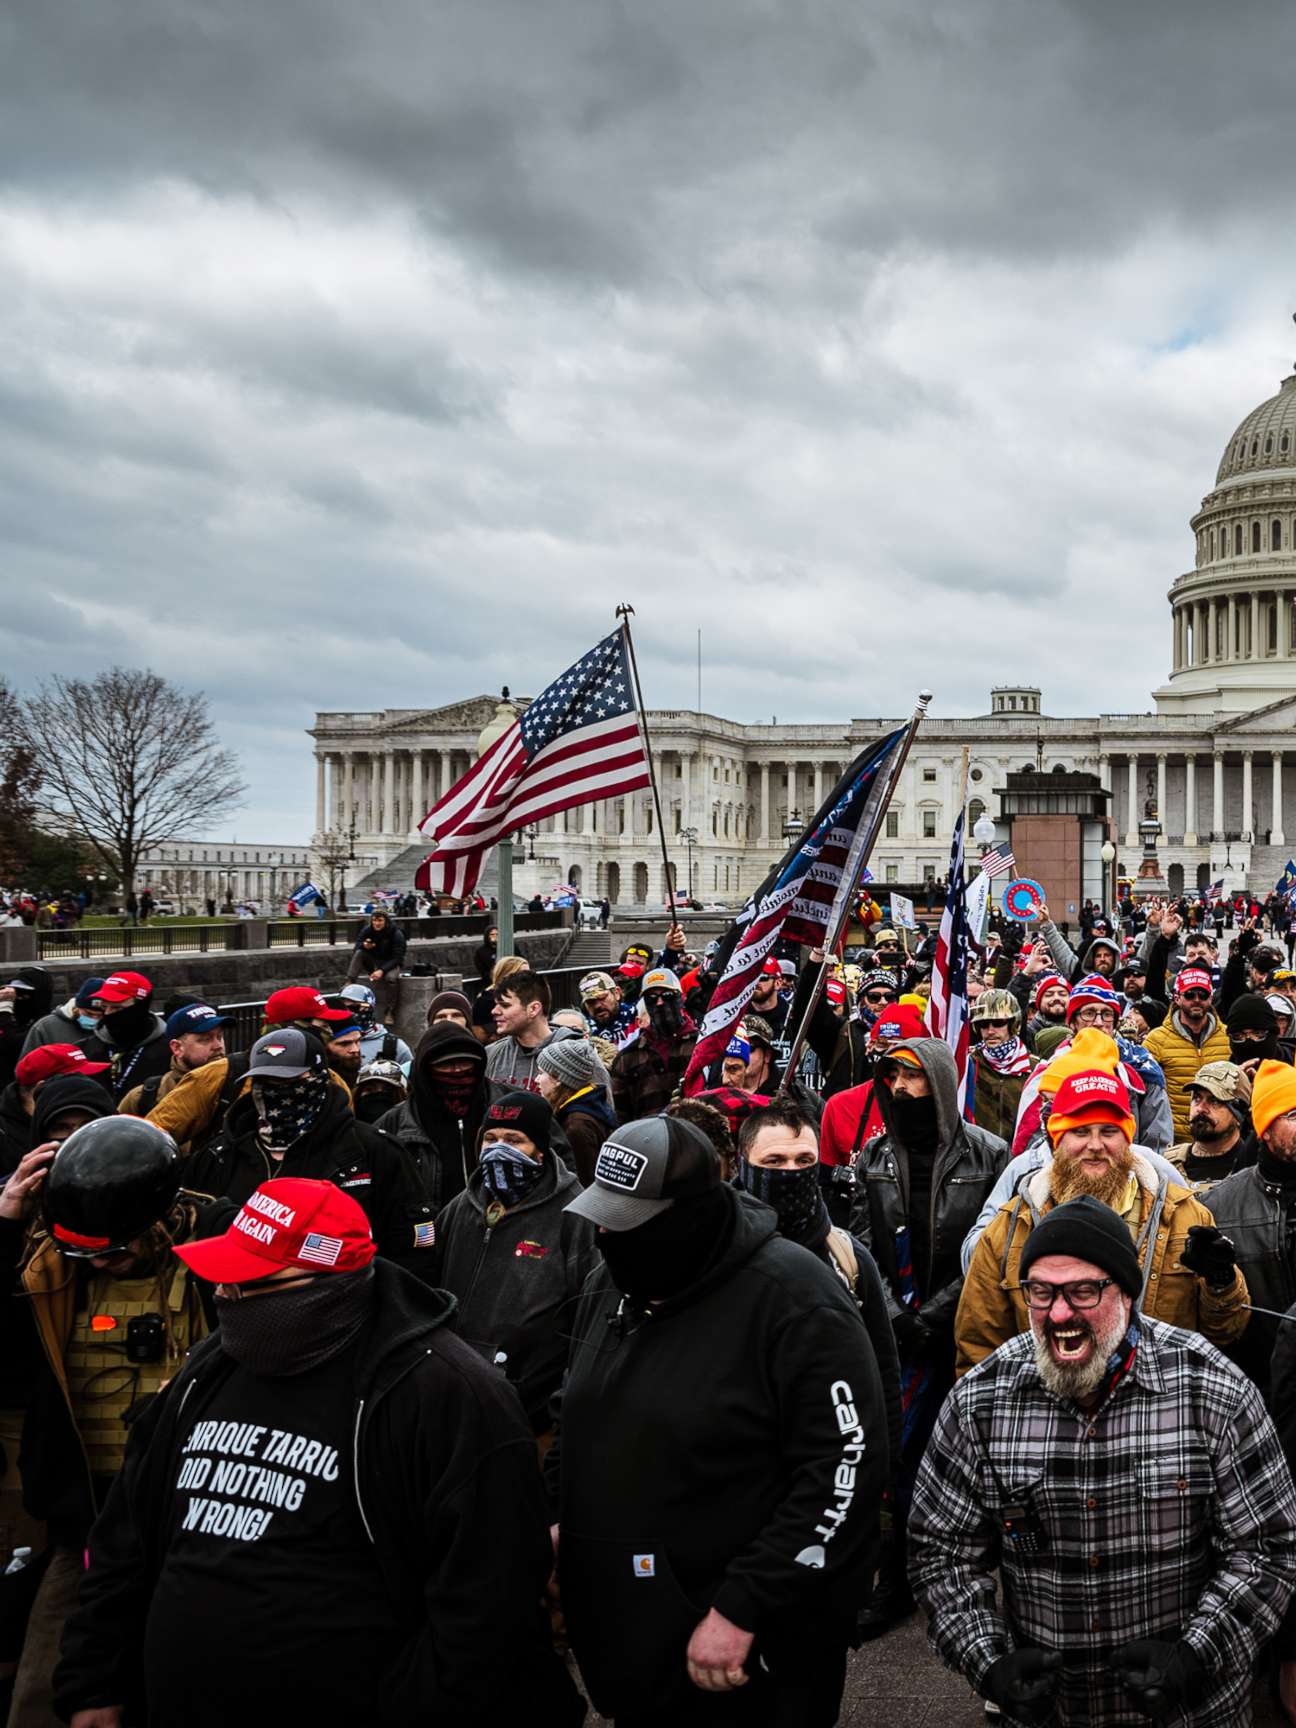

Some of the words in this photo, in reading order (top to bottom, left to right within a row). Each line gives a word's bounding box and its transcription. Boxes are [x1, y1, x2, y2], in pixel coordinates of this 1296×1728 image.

[182, 1420, 268, 1457] NRIQUE
[815, 1380, 866, 1542] carhartt
[176, 1457, 212, 1489] DID
[208, 1459, 306, 1512] NOTHING
[181, 1497, 274, 1542] WRONG!
